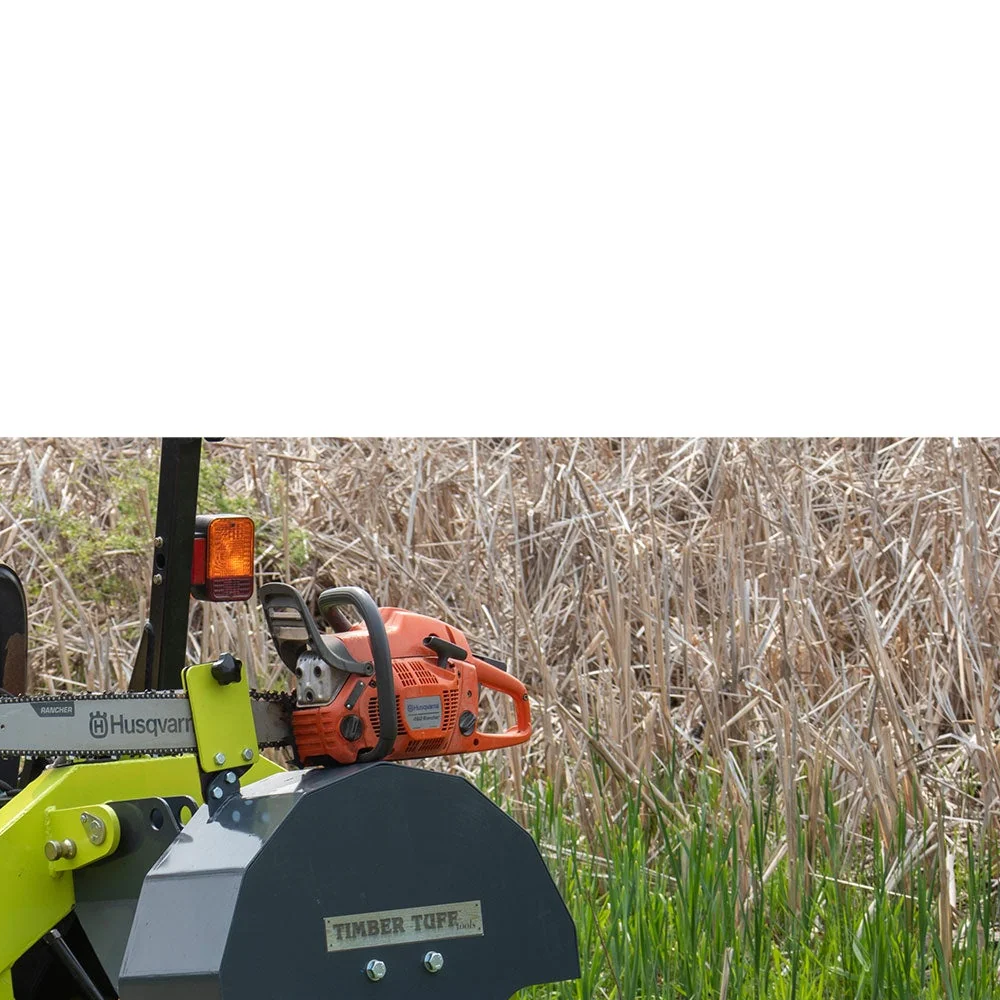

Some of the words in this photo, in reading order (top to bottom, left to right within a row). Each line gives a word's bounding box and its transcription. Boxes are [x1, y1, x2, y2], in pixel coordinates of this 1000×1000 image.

[40, 706, 73, 714] RANCHER
[110, 714, 192, 737] Husqvarn
[333, 916, 405, 940] TIMBER
[411, 910, 458, 931] TUFF
